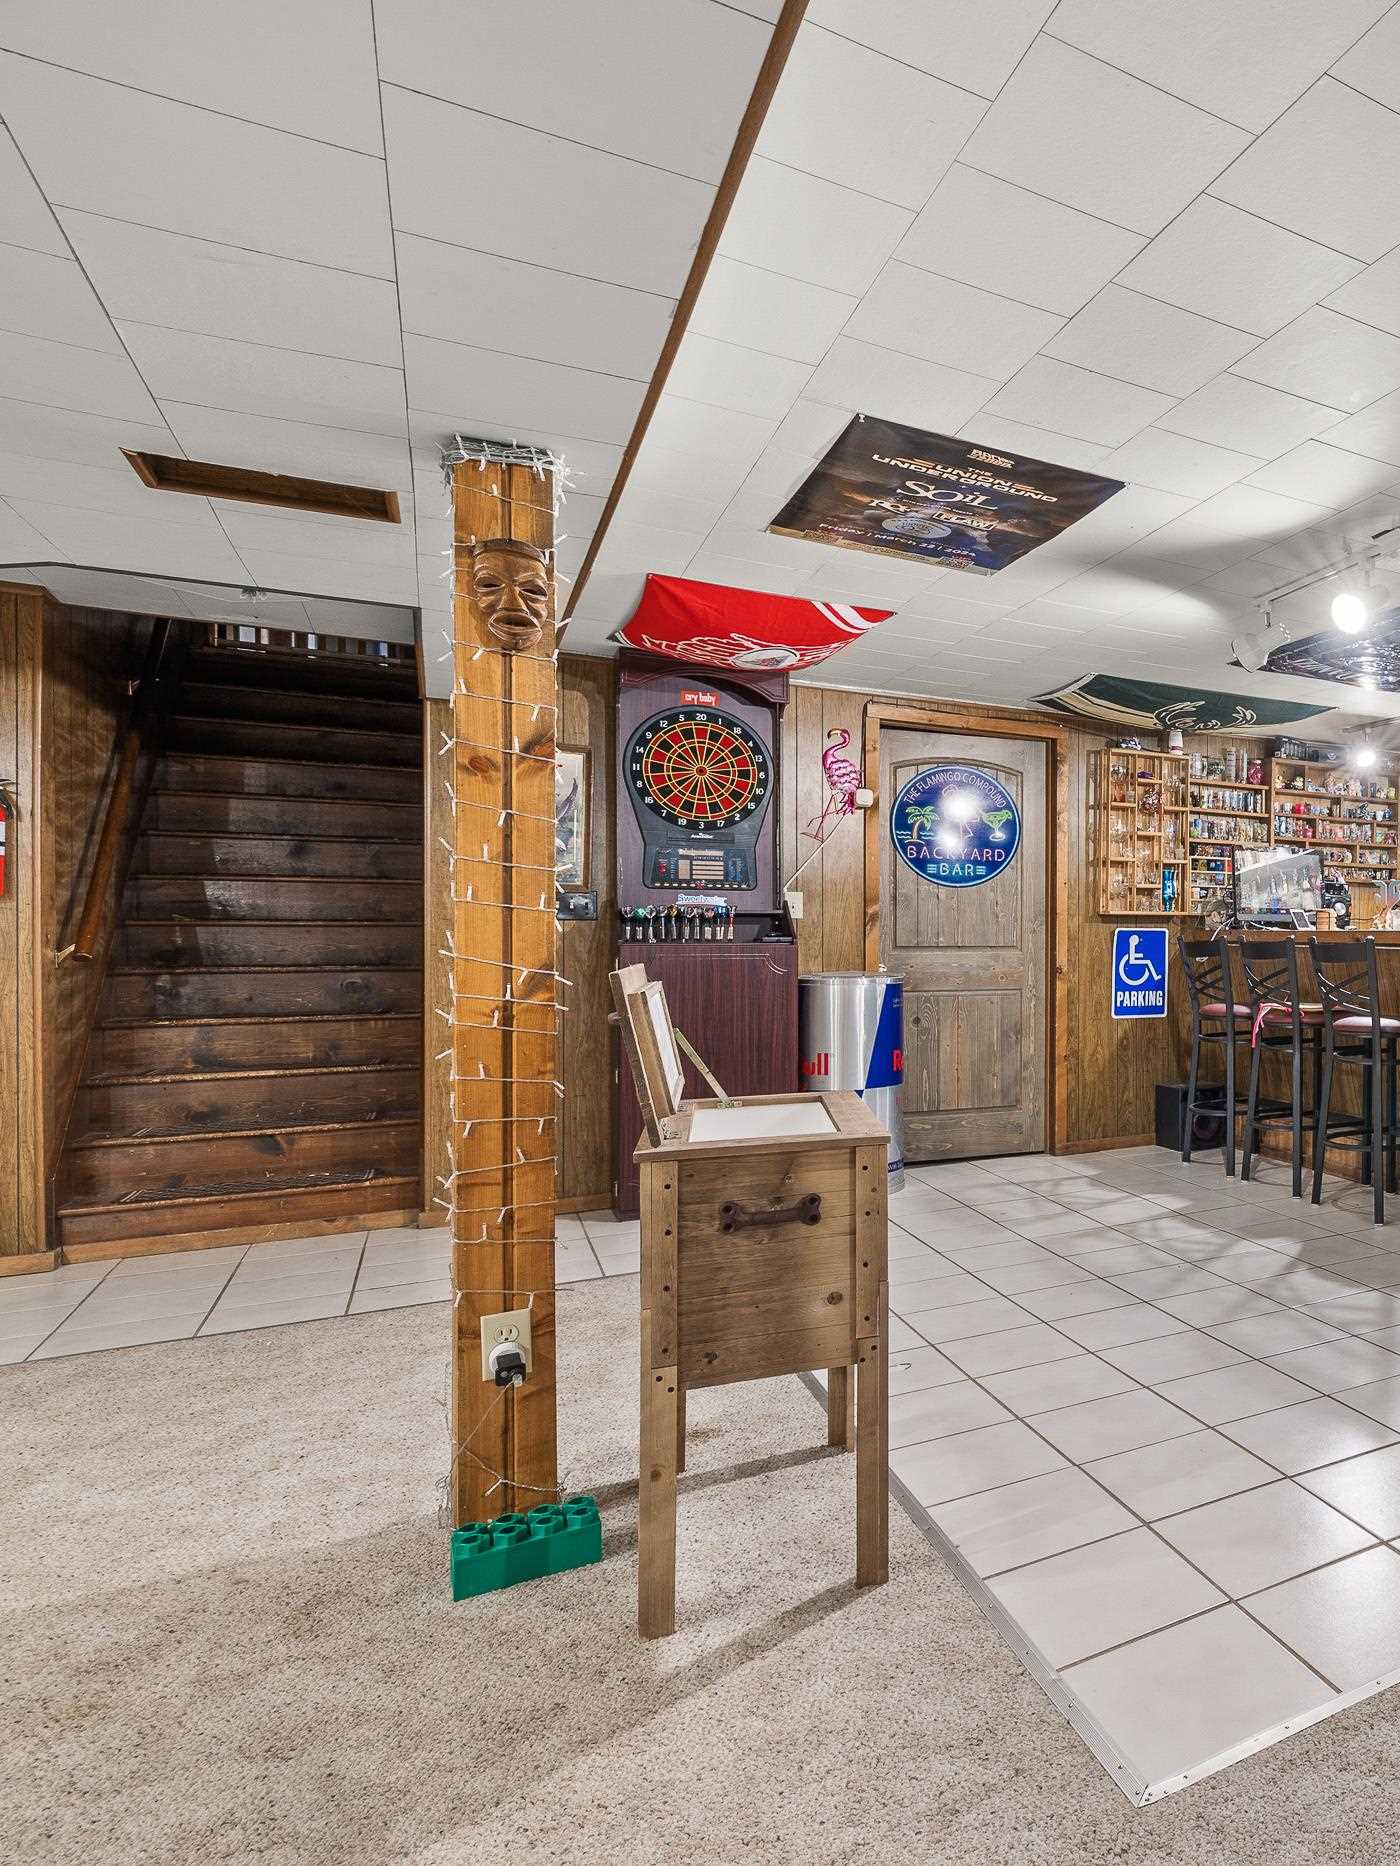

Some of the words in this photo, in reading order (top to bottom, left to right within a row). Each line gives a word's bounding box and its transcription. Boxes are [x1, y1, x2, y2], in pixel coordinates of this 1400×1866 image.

[872, 454, 1058, 503] UNDERGROUND
[684, 692, 697, 705] cry
[699, 691, 717, 707] baby
[678, 714, 685, 722] 5
[695, 713, 707, 721] 20
[659, 720, 668, 728] 12
[733, 726, 742, 735] 18
[645, 731, 652, 739] 9
[635, 746, 644, 754] 14
[755, 754, 763, 763] 13
[632, 763, 640, 771] 11
[759, 771, 765, 779] 6
[636, 780, 643, 788] 8
[755, 787, 764, 795] 10
[903, 783, 921, 805] THE
[918, 772, 961, 792] FLAMINGO
[962, 772, 1007, 808] COMPOUND
[644, 796, 654, 804] 16
[747, 802, 756, 810] 15
[661, 809, 667, 817] 7
[678, 818, 687, 826] 19
[698, 821, 704, 829] 3
[907, 845, 1006, 862] BACKYARD
[939, 862, 975, 876] BAR
[1116, 990, 1163, 1008] PARKING
